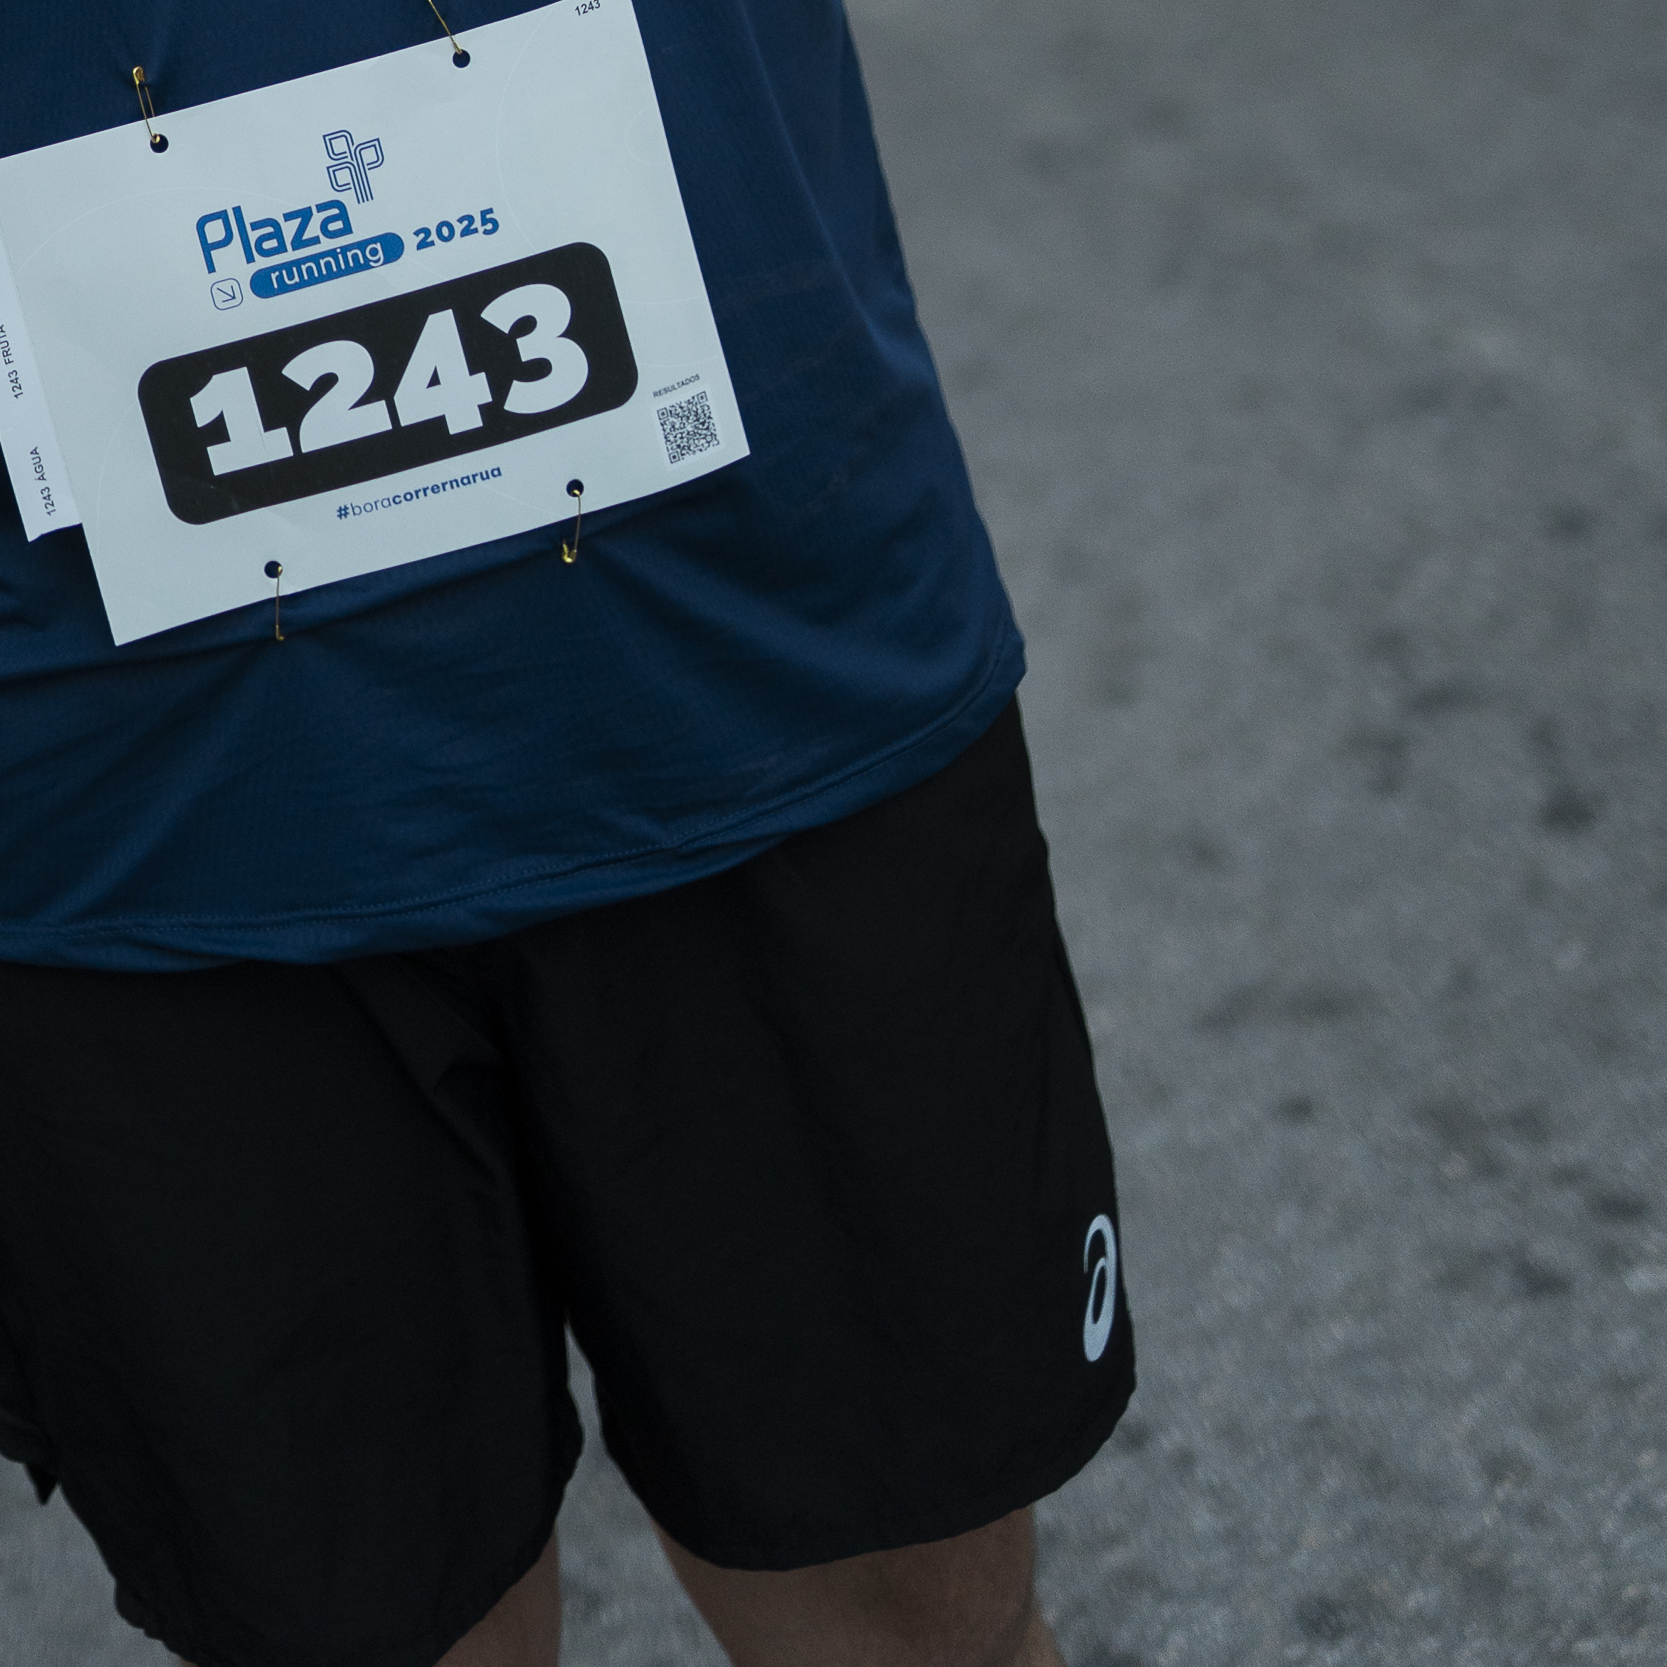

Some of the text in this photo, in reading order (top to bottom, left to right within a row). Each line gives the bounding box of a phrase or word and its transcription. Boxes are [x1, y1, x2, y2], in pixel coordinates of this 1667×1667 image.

[196, 199, 353, 274] Plaza
[413, 207, 500, 251] 2025
[269, 241, 385, 289] running
[7, 369, 24, 399] 1243
[189, 283, 589, 476] 1243
[29, 446, 56, 516] 1243 ÁGUA
[336, 467, 503, 520] #boracorrernarua
